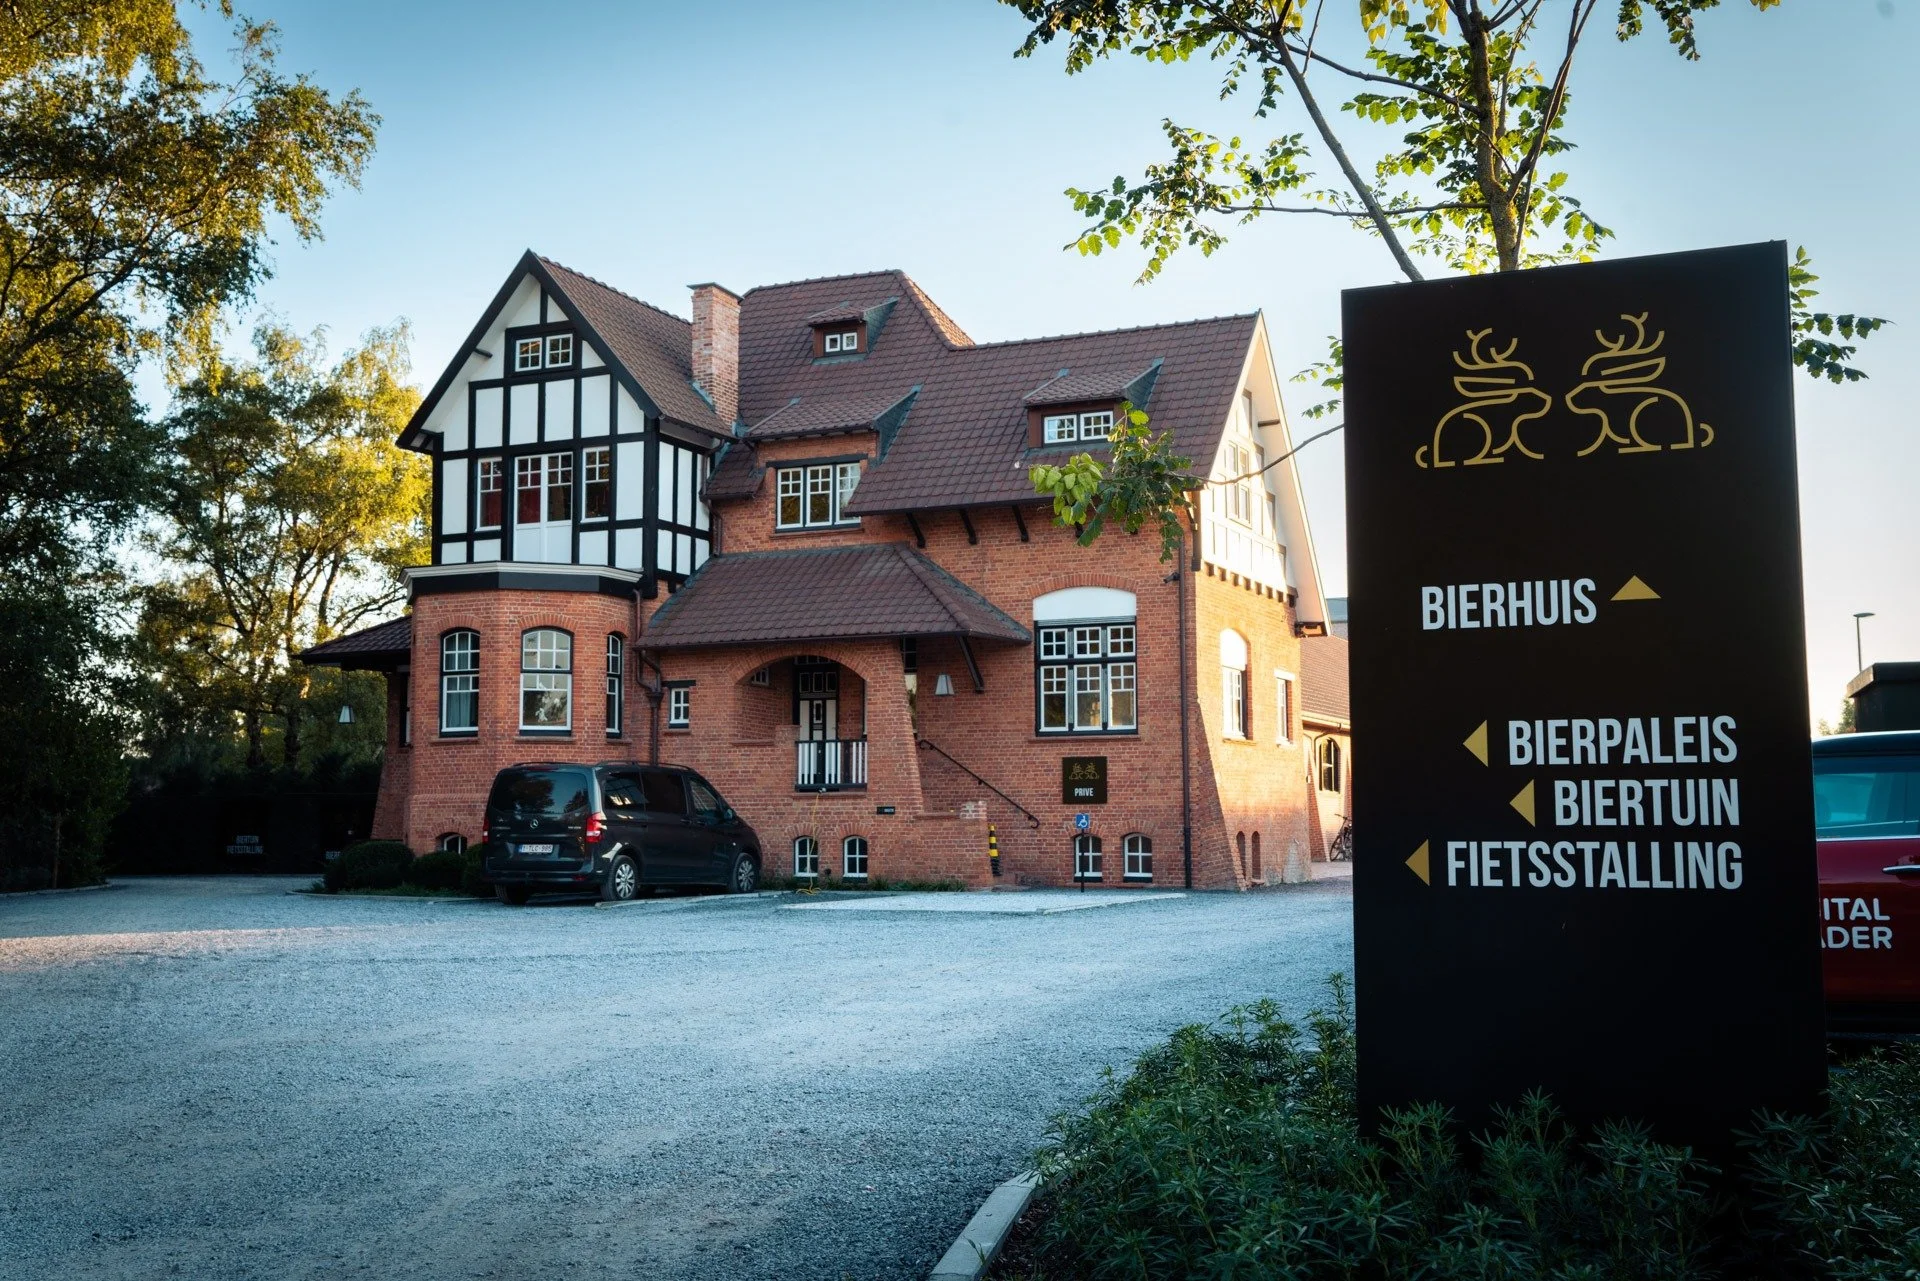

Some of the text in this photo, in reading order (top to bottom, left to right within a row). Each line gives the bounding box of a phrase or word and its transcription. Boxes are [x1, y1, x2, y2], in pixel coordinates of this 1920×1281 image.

[1421, 578, 1598, 630] BIERHUIS
[1508, 715, 1738, 766] BIERPALEIS
[1074, 787, 1094, 797] PRIVE
[1554, 778, 1740, 826] BIERTUIN
[1447, 841, 1744, 890] FIETSSTALLING
[1820, 897, 1891, 921] ITAL
